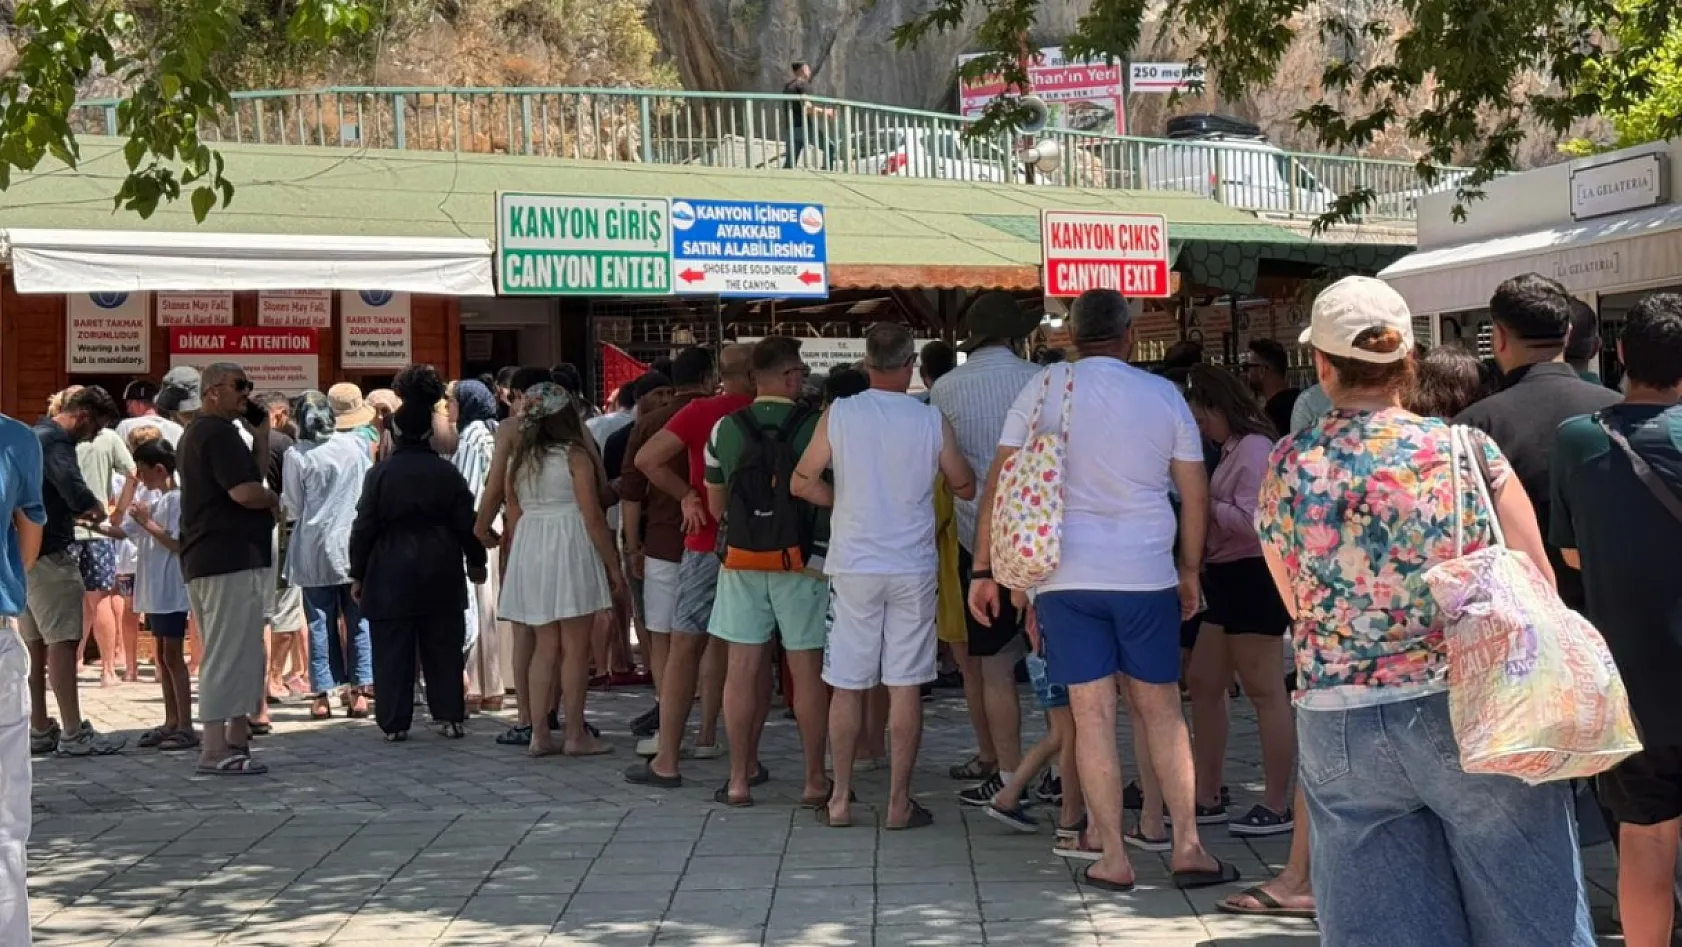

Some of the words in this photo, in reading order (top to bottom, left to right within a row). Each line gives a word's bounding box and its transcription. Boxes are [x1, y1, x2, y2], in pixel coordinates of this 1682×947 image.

[1087, 66, 1116, 82] Yeri
[1134, 67, 1158, 78] 250
[1582, 187, 1595, 200] LA
[1597, 176, 1648, 197] GELATERIA
[696, 205, 753, 222] KANYON
[755, 203, 798, 224] İÇİNDE
[510, 206, 599, 239] KANYON
[605, 202, 662, 248] GİRİŞ
[716, 224, 781, 240] AYAKKABI
[1051, 222, 1114, 251] KANYON
[1119, 223, 1160, 258] ÇIKIŞ
[682, 240, 722, 255] SATIN
[724, 239, 816, 258] ALABİLİRSİNİZ
[506, 253, 597, 289] CANYON
[602, 255, 667, 289] ENTER
[703, 263, 730, 274] SHOES
[732, 263, 747, 274] ARE
[749, 264, 772, 275] SOLD
[772, 264, 798, 276] INSIDE
[1057, 263, 1121, 291] CANYON
[1123, 264, 1157, 292] EXIT
[725, 279, 741, 290] THE
[742, 279, 779, 291] CANYON.
[161, 299, 189, 311] Stones
[191, 299, 211, 313] May
[263, 300, 290, 312] Stones
[292, 300, 308, 314] May
[74, 319, 103, 328] BARET
[106, 318, 143, 328] TAKMAK
[162, 314, 183, 325] Wear
[185, 314, 191, 325] A
[193, 314, 212, 325] Hard
[263, 315, 284, 325] Wear
[284, 315, 290, 325] A
[292, 315, 311, 326] Hard
[346, 315, 372, 324] BARET
[374, 315, 406, 324] TAKMAK
[77, 330, 139, 340] ZORUNLUDUR
[349, 327, 403, 335] ZORUNLUDUR
[179, 331, 227, 350] DİKKAT
[240, 332, 311, 350] ATTENTİON
[349, 339, 380, 348] Wearing
[387, 339, 404, 347] hard
[77, 344, 112, 354] Wearing
[114, 345, 119, 353] a
[121, 344, 141, 353] hard
[72, 355, 87, 364] hat
[88, 355, 95, 364] is
[97, 355, 145, 366] mandatory.
